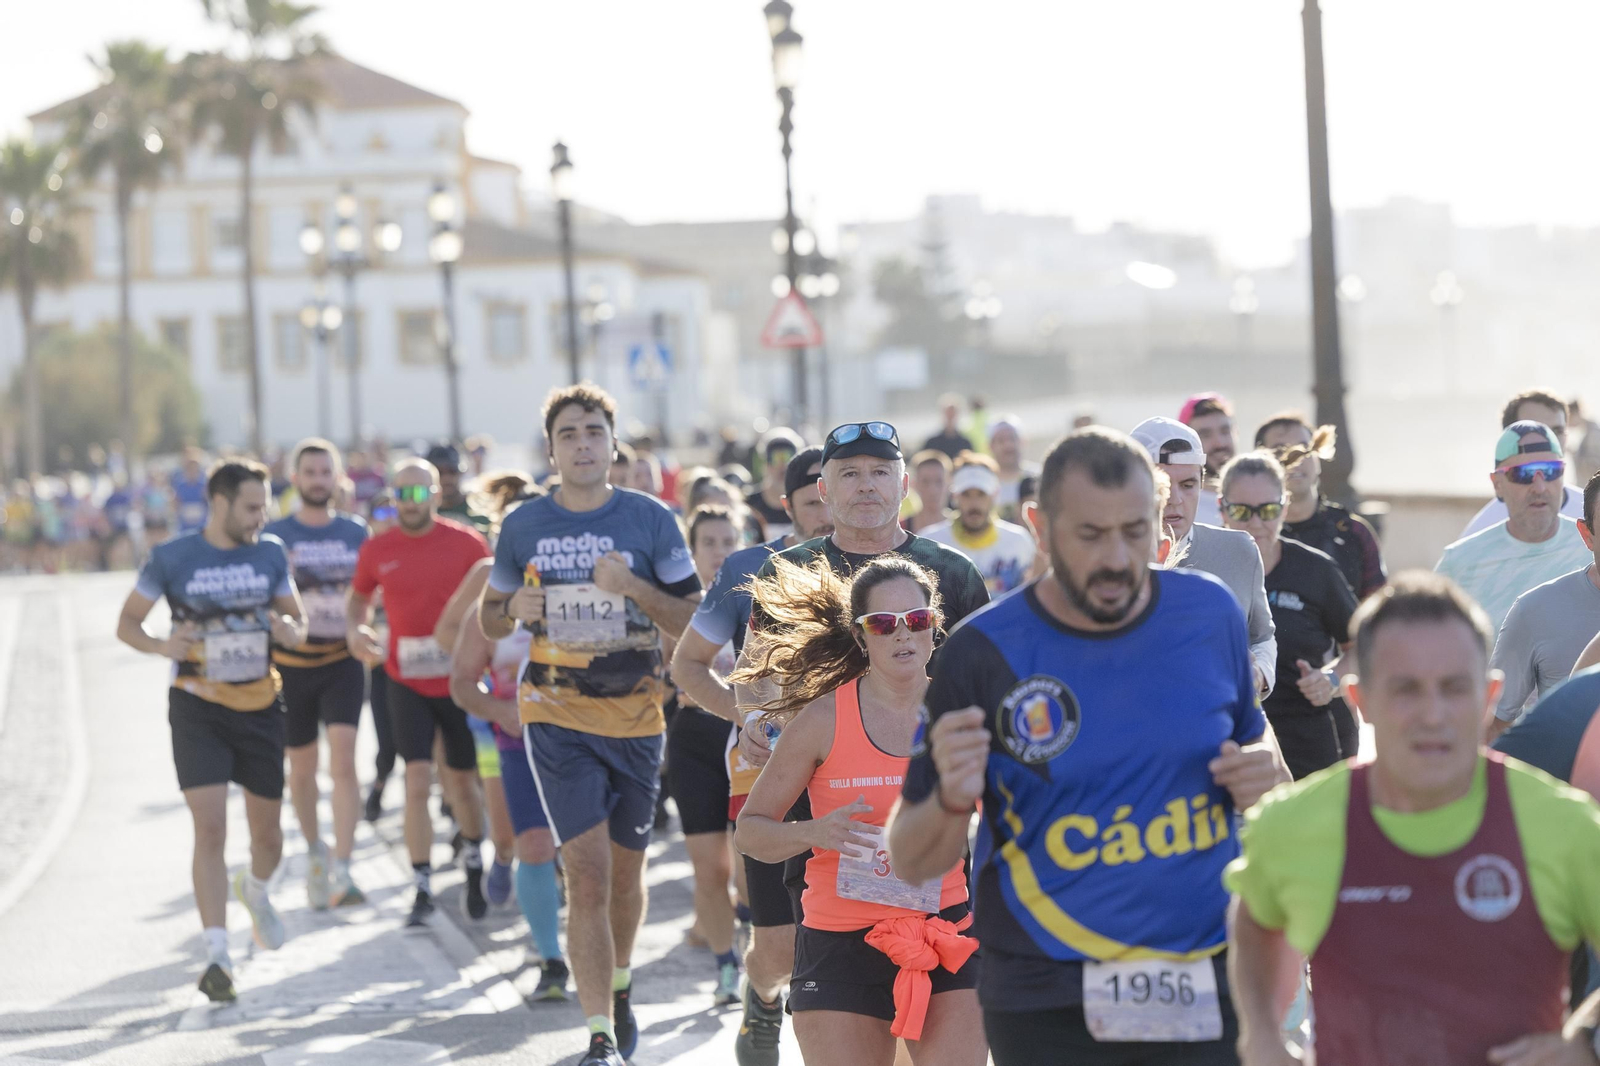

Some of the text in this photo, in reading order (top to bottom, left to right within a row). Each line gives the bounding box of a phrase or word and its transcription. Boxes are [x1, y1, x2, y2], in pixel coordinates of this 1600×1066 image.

[536, 532, 614, 555] media
[558, 600, 613, 621] 1112
[829, 775, 903, 789] SEVILLA RUNNING CLUB
[1104, 970, 1195, 1007] 1956
